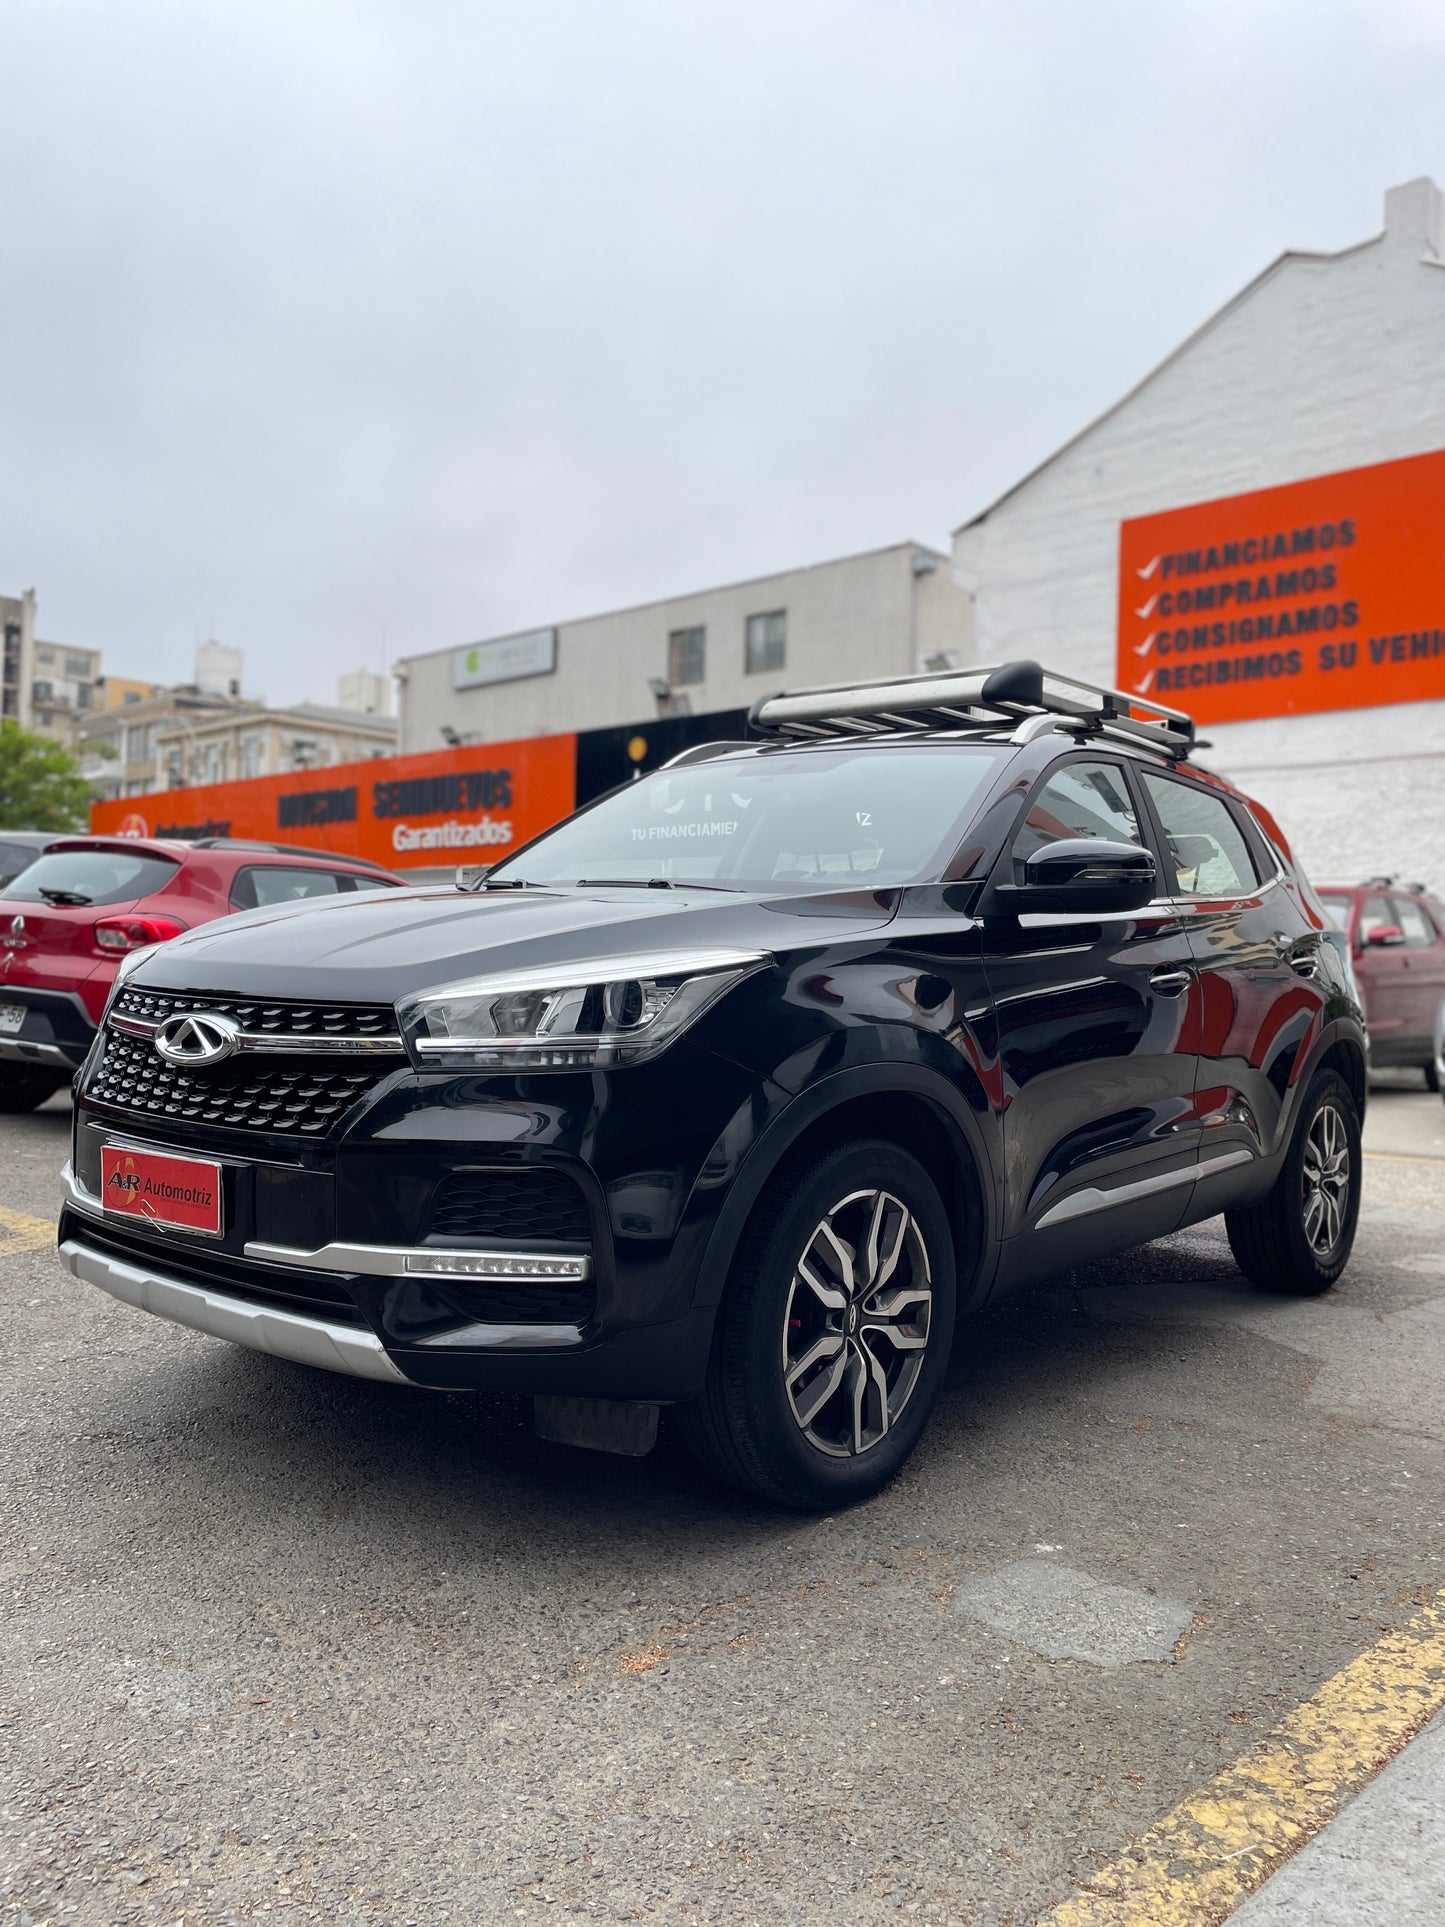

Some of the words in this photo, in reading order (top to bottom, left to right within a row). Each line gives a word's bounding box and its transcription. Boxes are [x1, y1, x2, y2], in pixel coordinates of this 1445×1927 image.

[1160, 519, 1357, 579] FINANCIAMOS
[1157, 563, 1338, 617] COMPRAMOS
[1155, 600, 1359, 655] CONSIGNAMOS
[1155, 649, 1302, 692] RECIBIMOS
[1318, 642, 1358, 671] SU
[1369, 628, 1445, 665] VEHI
[392, 814, 513, 852] Garantizados
[631, 827, 647, 840] TU
[143, 1178, 213, 1206] Automotriz
